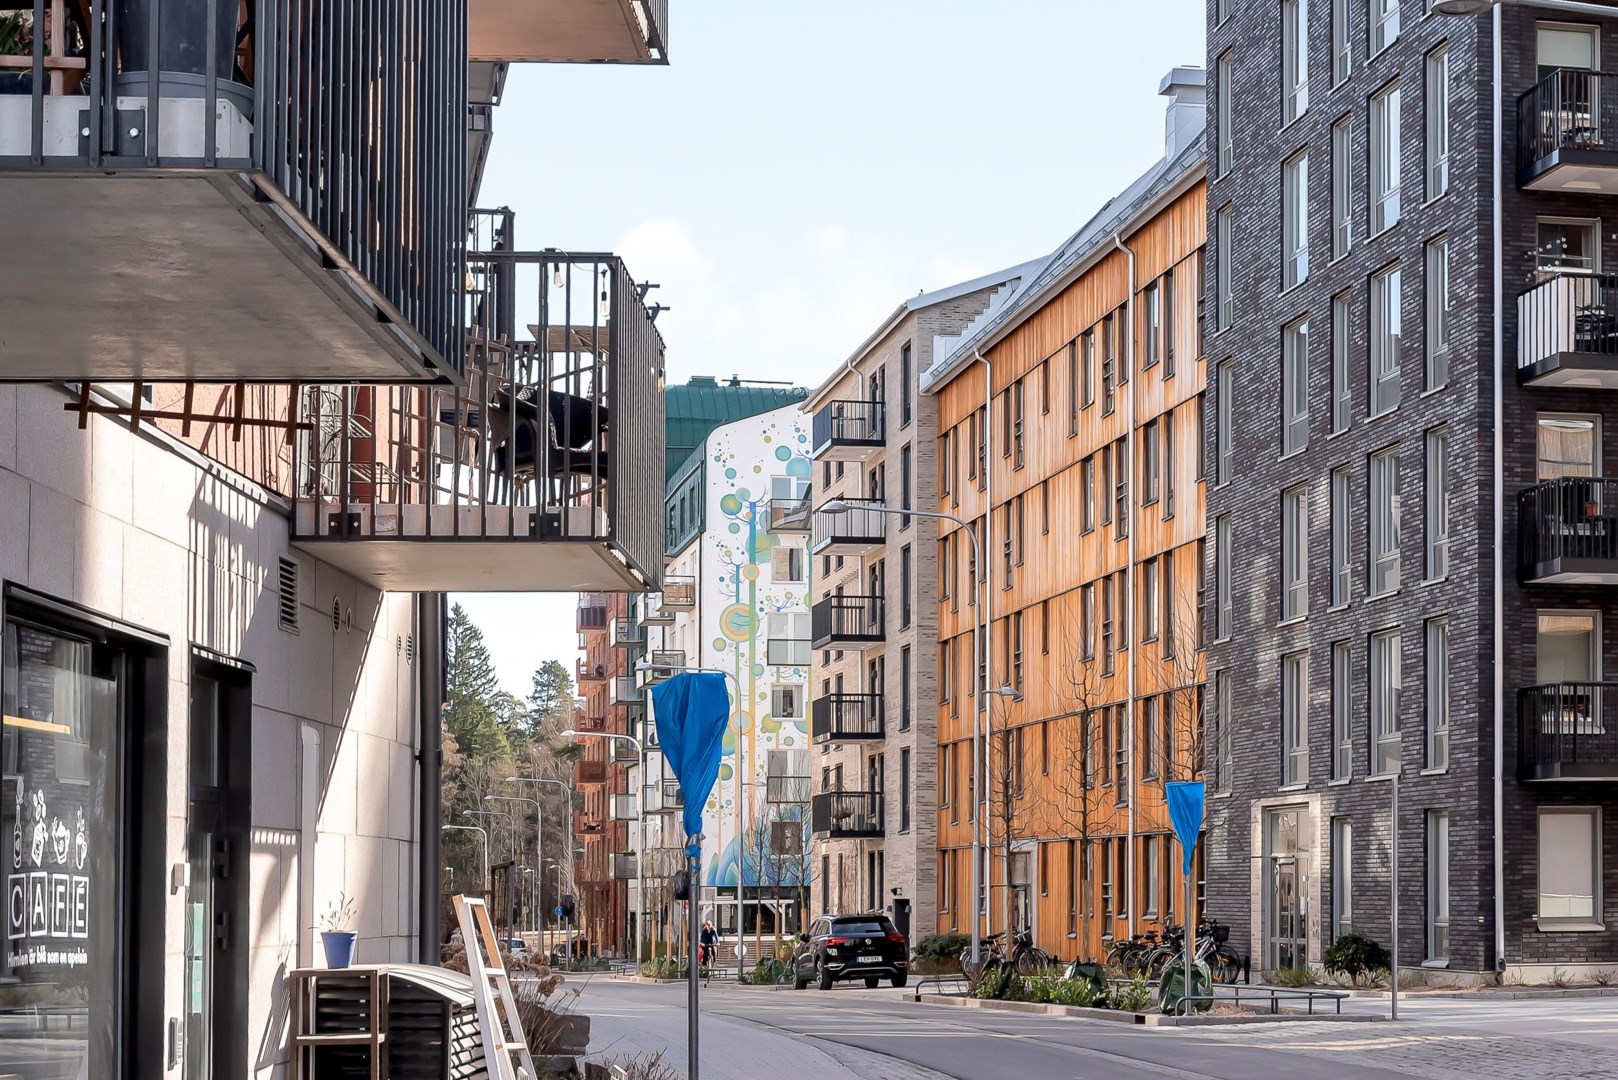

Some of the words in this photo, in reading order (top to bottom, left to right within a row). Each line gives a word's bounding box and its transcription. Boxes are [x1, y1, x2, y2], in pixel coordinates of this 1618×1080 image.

[11, 881, 85, 928] CAFÉ
[29, 947, 36, 964] är
[47, 952, 59, 964] som
[60, 952, 67, 964] en
